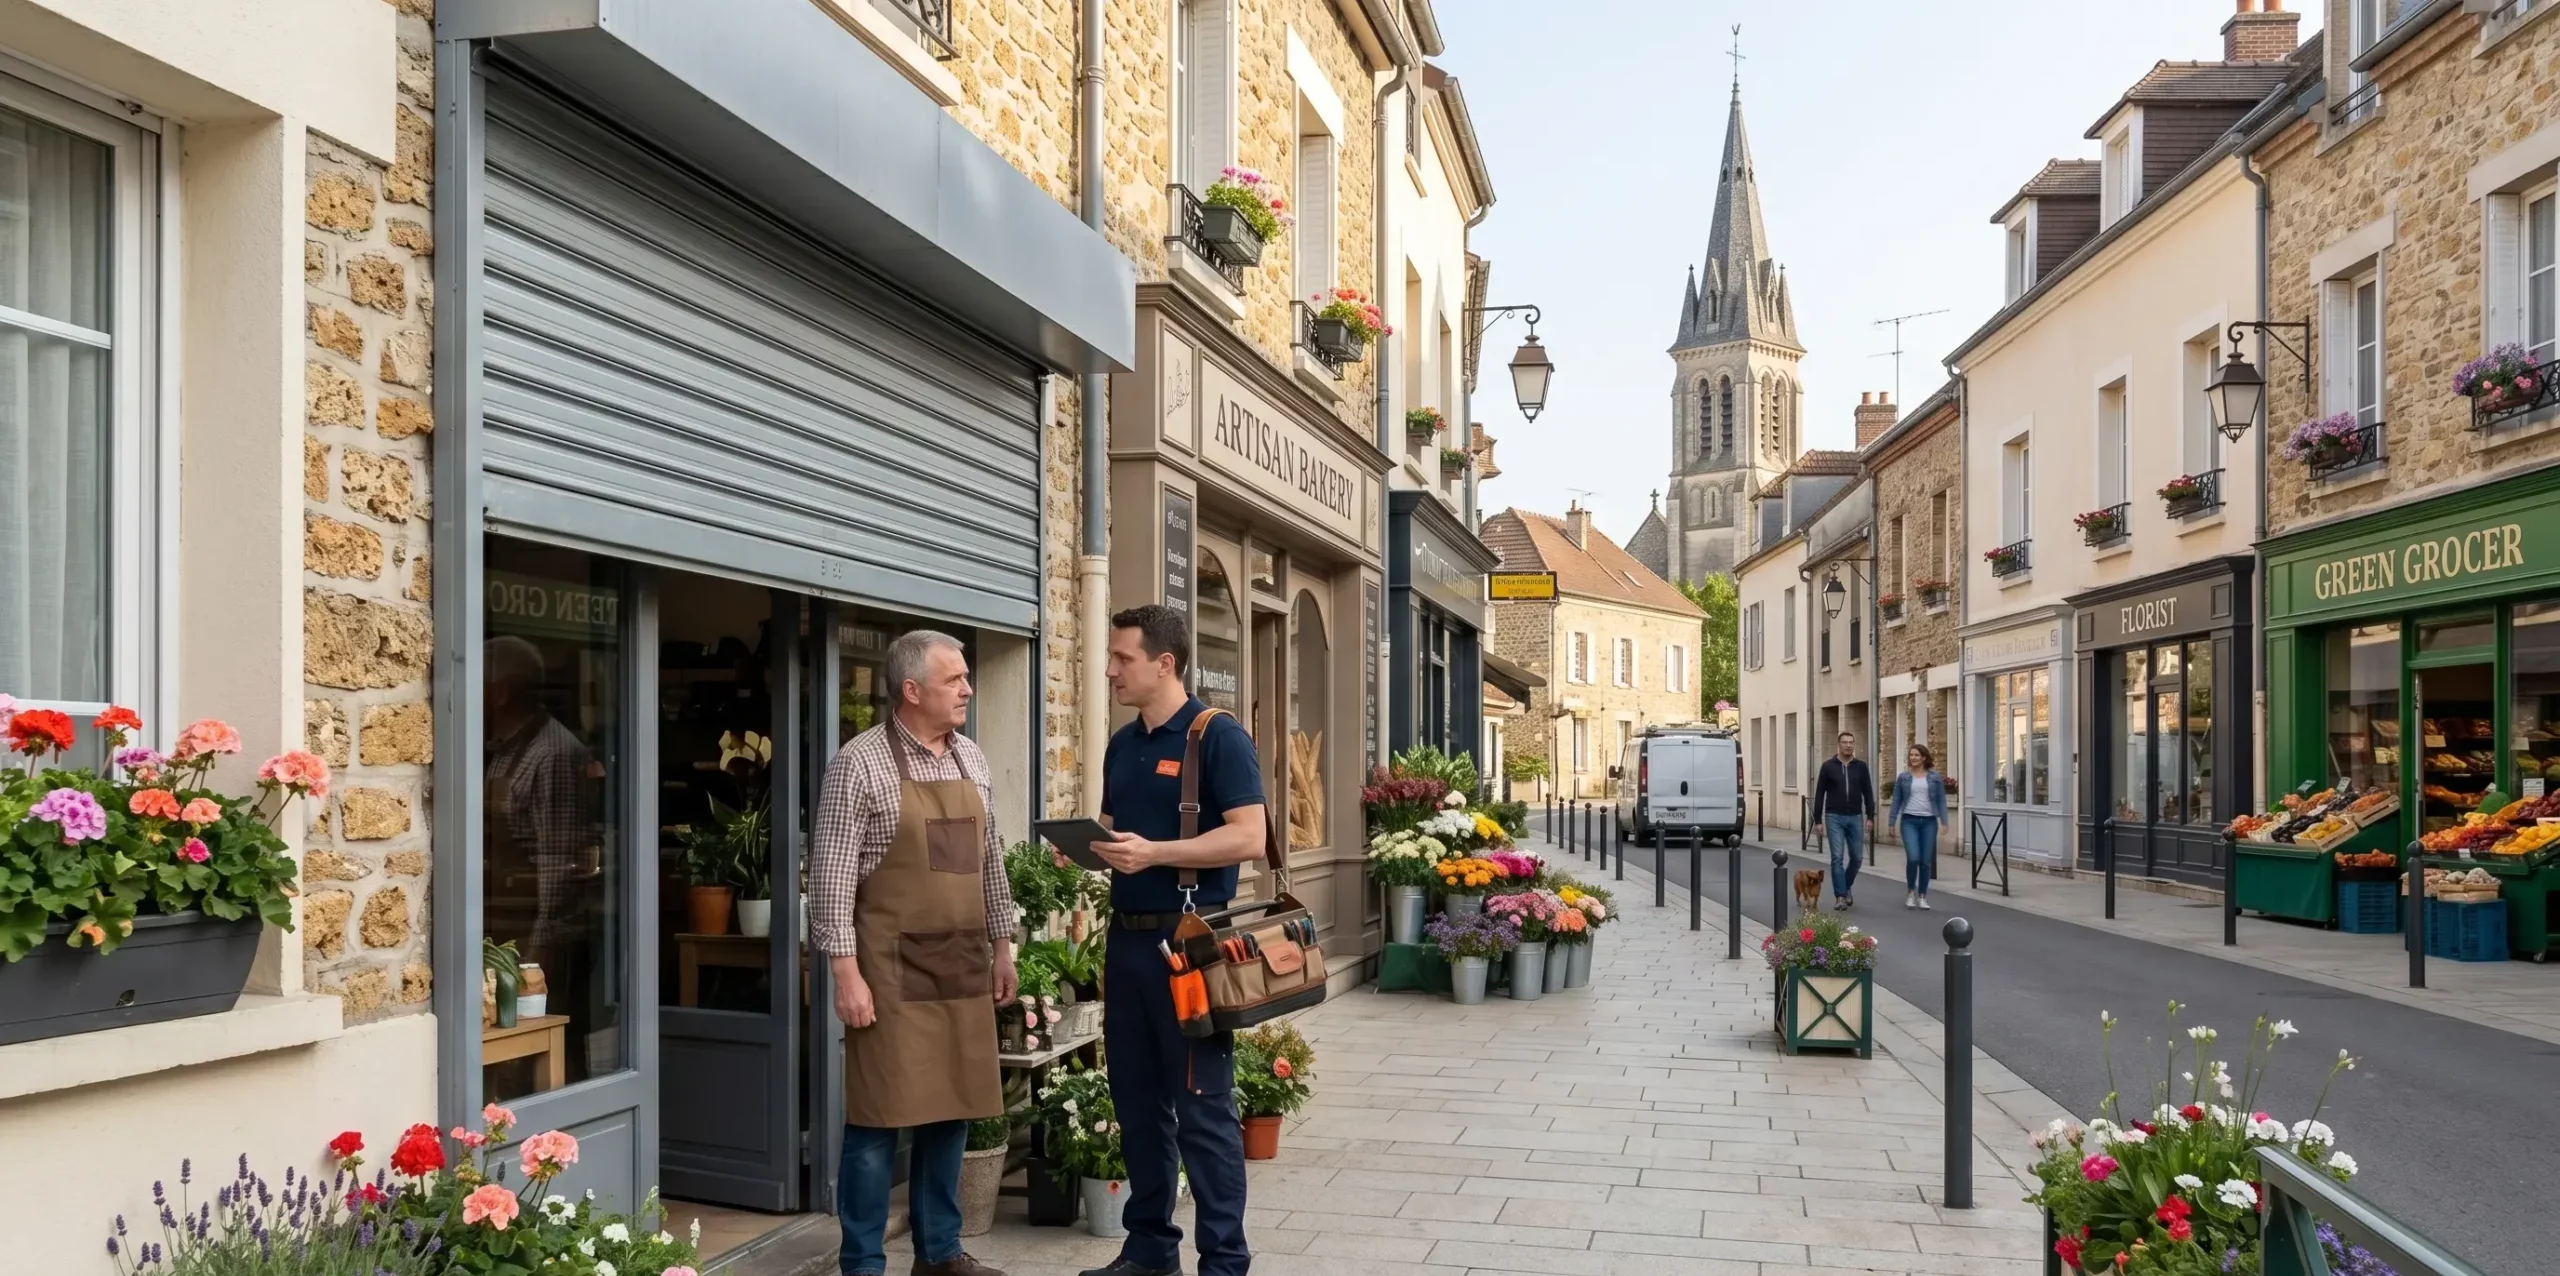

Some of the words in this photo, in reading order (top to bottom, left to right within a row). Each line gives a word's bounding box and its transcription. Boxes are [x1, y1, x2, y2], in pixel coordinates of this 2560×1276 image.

[1214, 393, 1295, 486] ARTISAN
[1298, 446, 1354, 521] BAKERY
[2315, 549, 2396, 600] GREEN
[2403, 523, 2525, 584] GROCER
[2121, 596, 2178, 635] FLORIST
